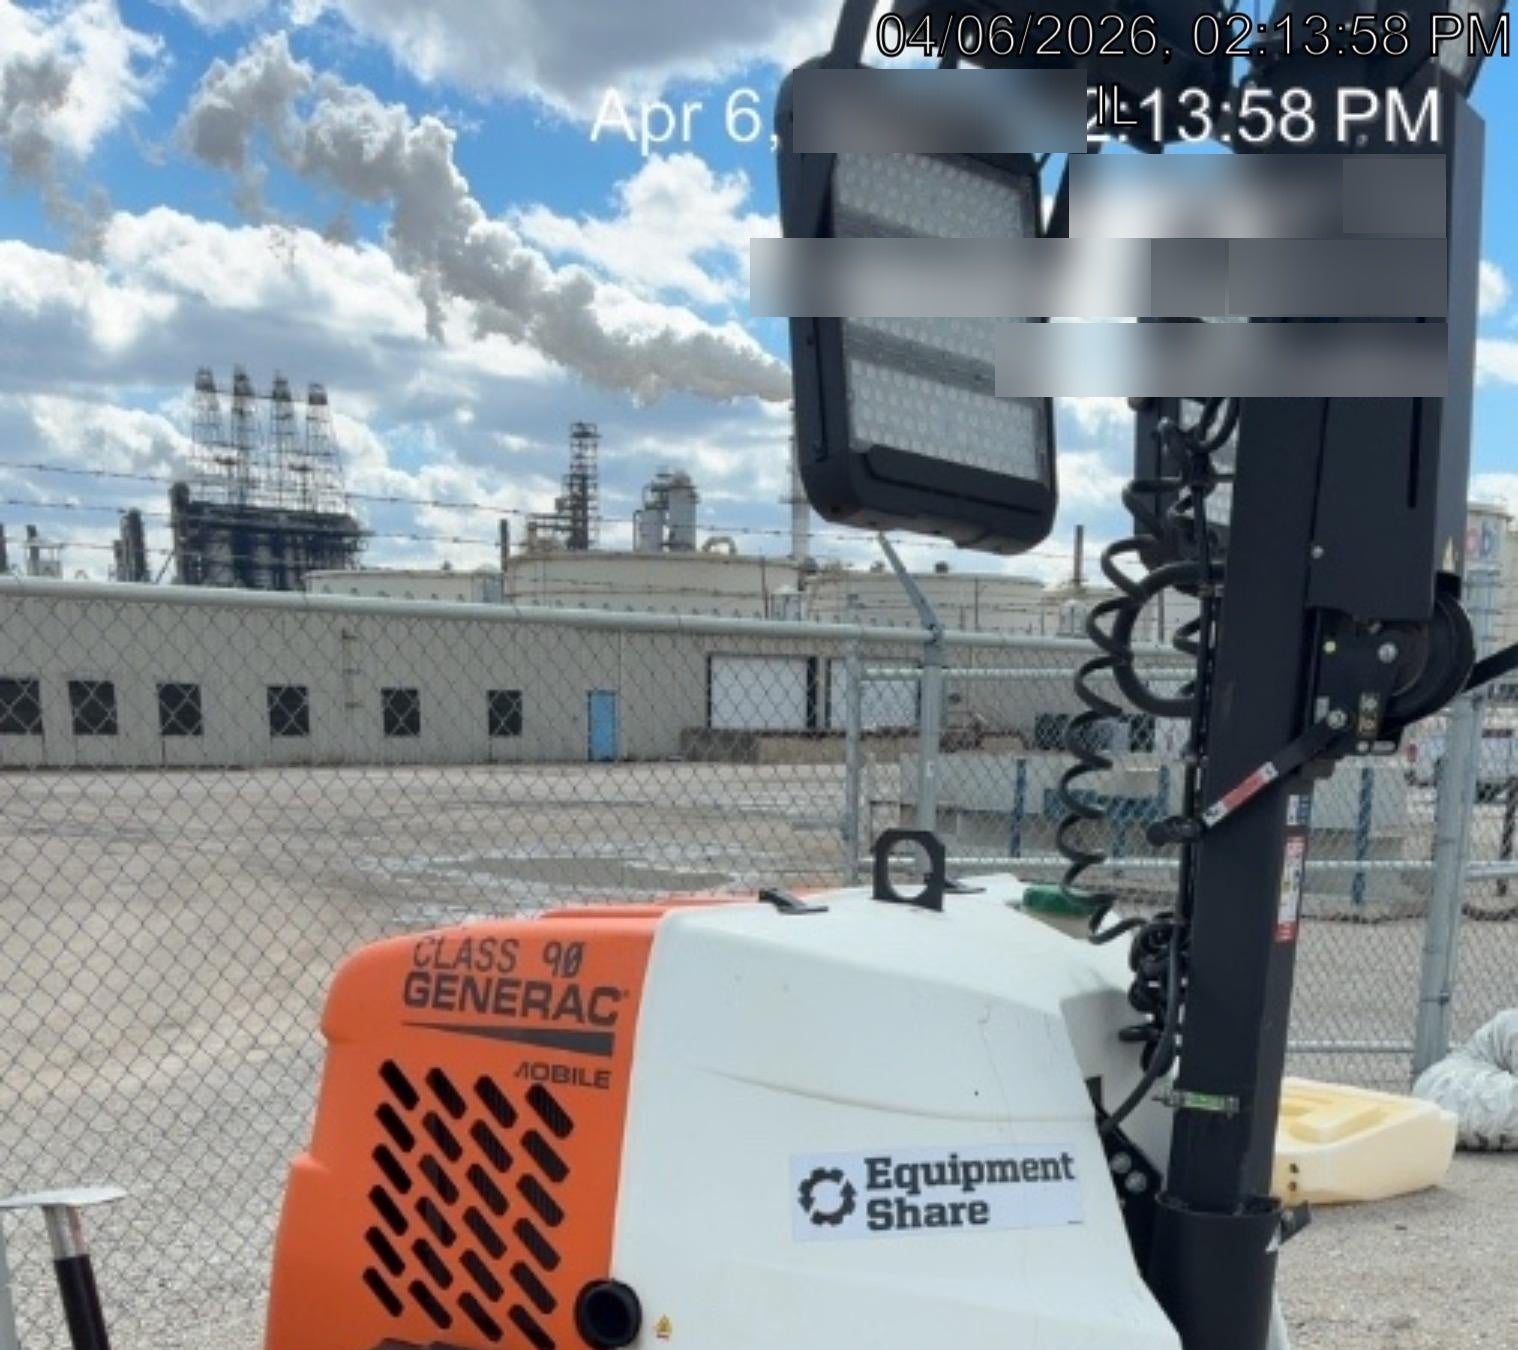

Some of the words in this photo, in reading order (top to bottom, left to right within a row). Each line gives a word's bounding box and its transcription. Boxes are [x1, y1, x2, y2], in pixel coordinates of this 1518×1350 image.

[412, 935, 520, 973] CLASS
[403, 970, 622, 1027] GENERAC
[865, 1151, 1075, 1195] Equipment
[866, 1196, 991, 1231] Share
